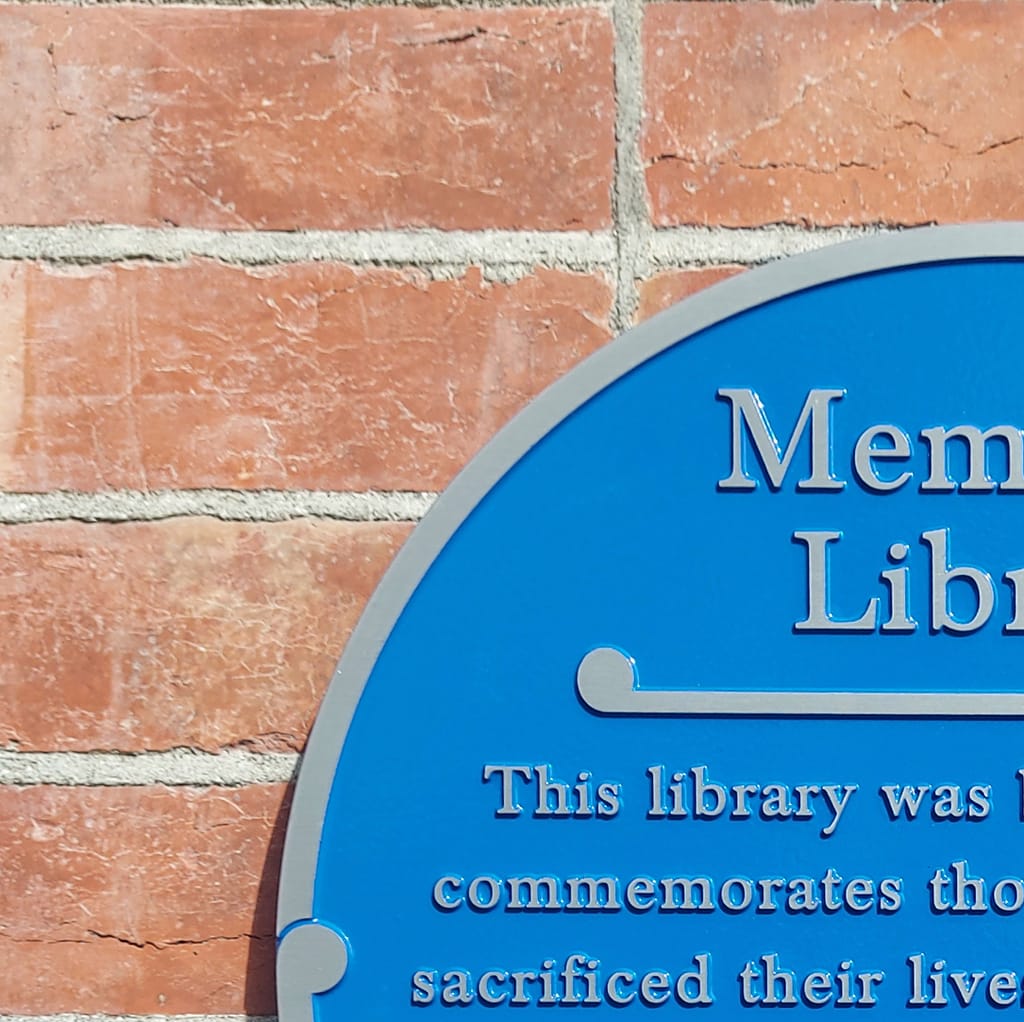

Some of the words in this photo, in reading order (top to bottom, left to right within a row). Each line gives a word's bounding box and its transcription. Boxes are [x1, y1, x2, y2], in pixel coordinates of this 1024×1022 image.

[484, 765, 618, 817] This
[649, 766, 856, 835] library
[882, 785, 991, 819] was
[434, 870, 904, 912] commemorates
[412, 954, 711, 1005] sacrificed
[740, 955, 882, 1006] their
